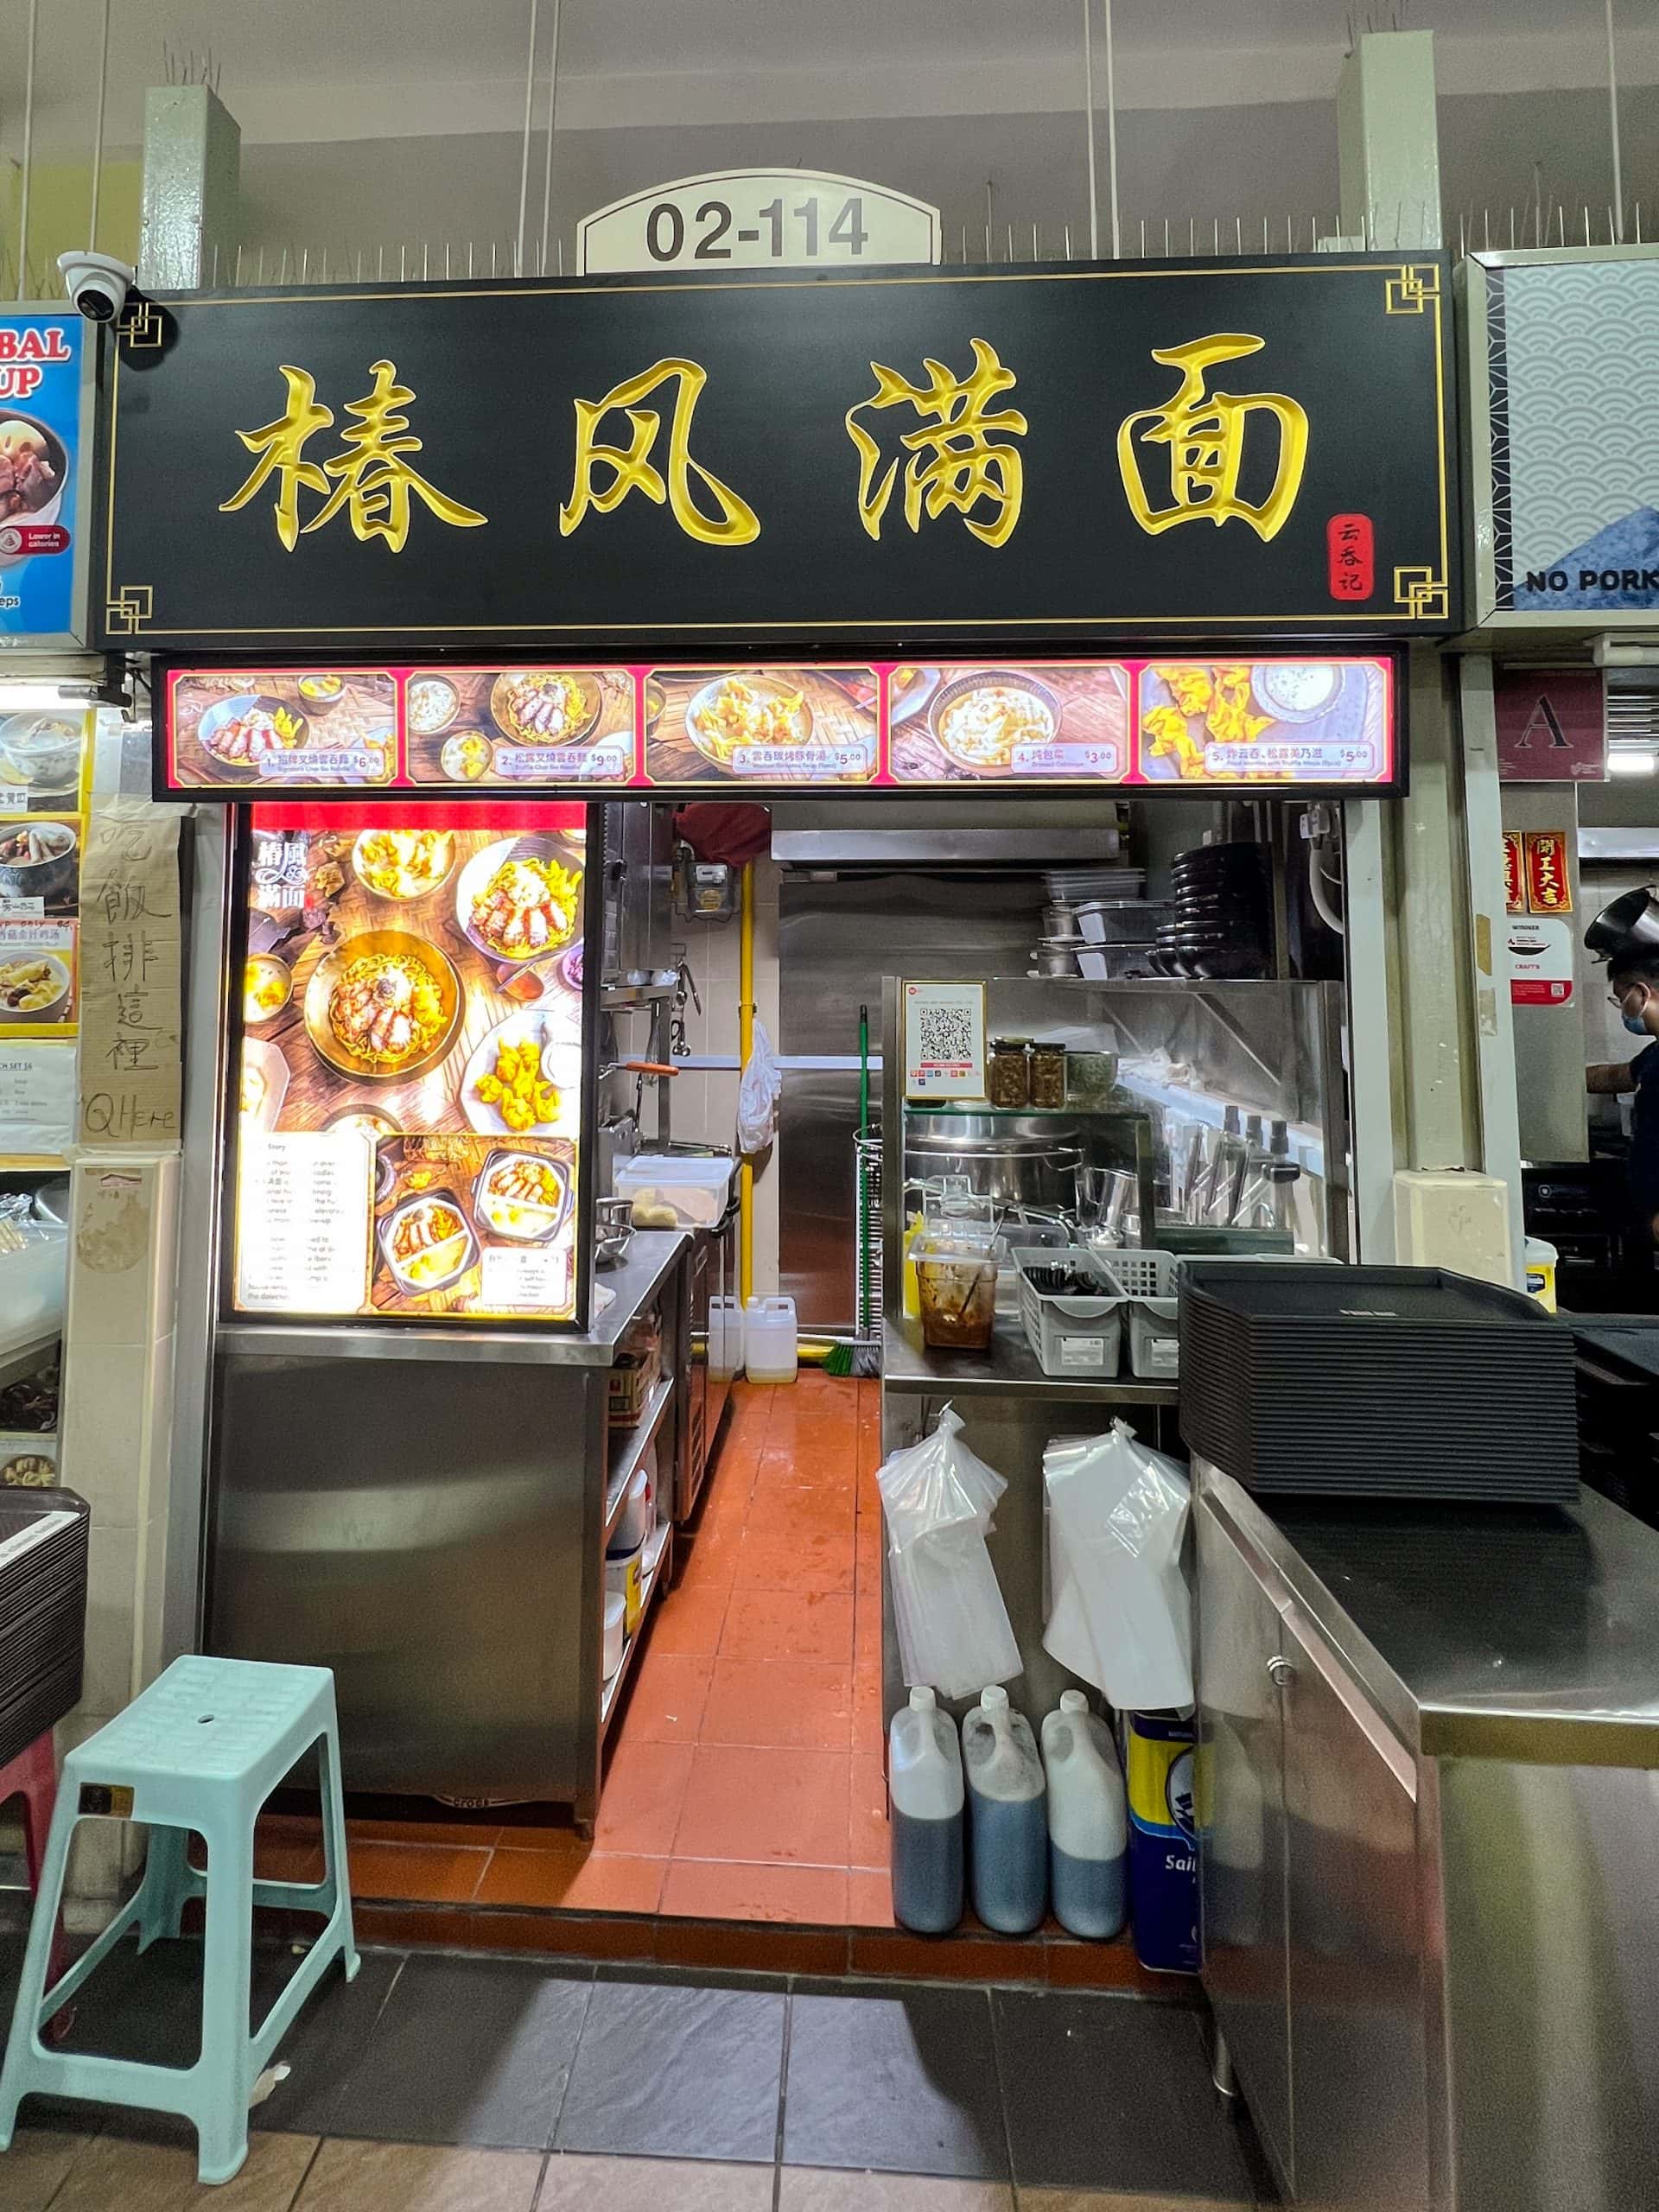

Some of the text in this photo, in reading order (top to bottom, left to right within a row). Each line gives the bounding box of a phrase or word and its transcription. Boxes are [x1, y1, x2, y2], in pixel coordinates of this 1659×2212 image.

[645, 197, 869, 262] 02-114
[1337, 523, 1363, 591] 云吞记
[1526, 569, 1659, 593] NO PORK
[1514, 693, 1574, 749] A
